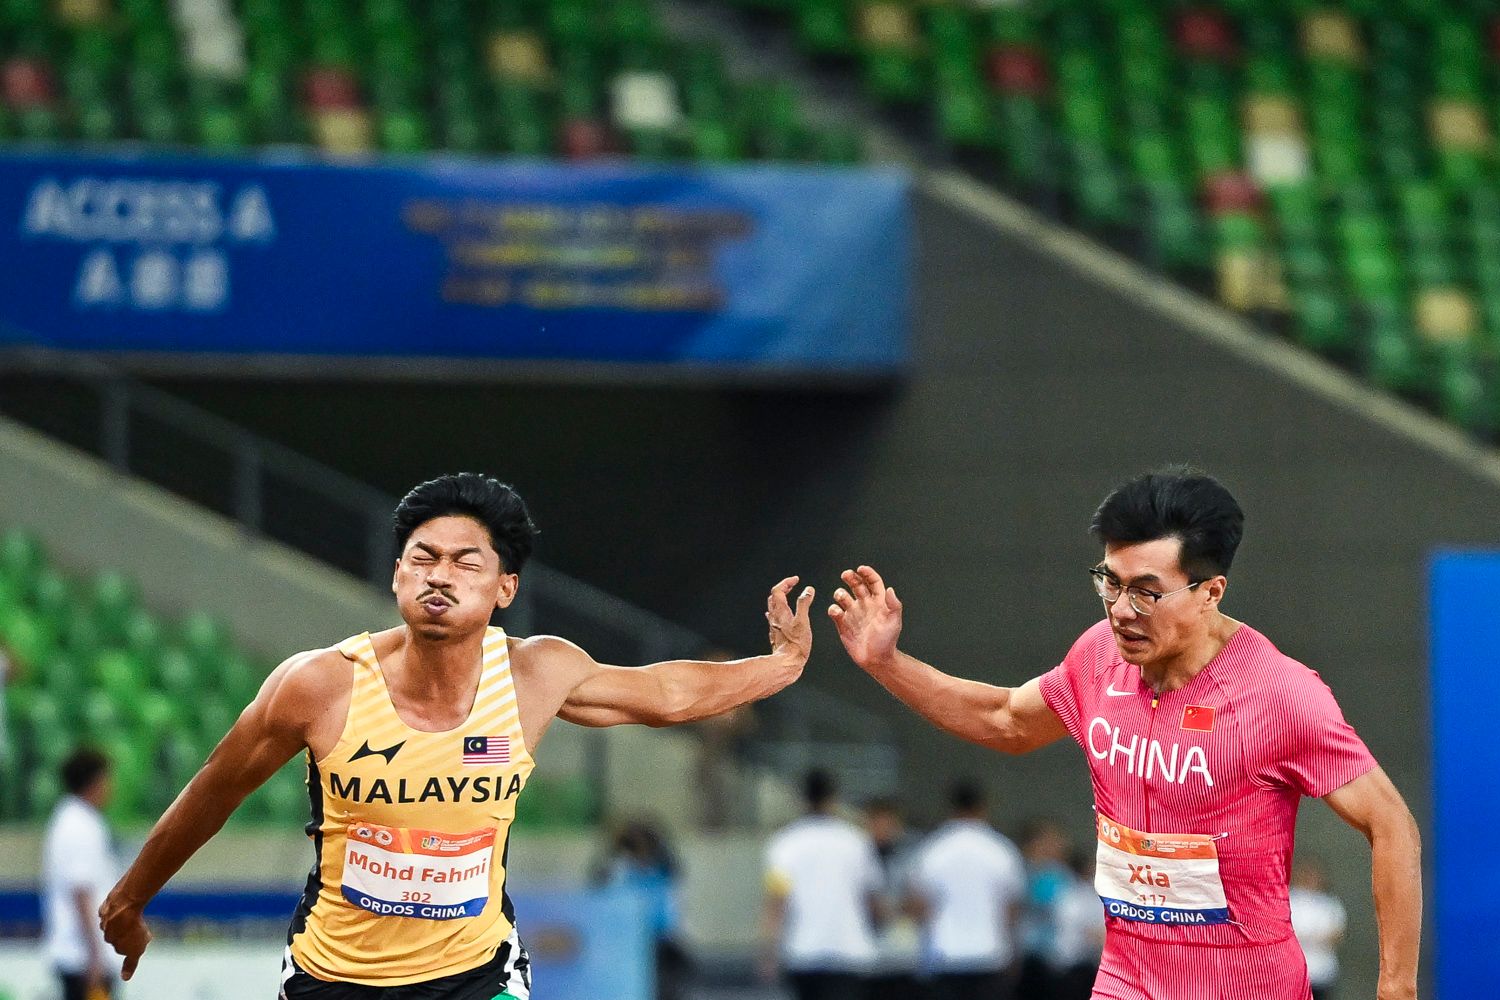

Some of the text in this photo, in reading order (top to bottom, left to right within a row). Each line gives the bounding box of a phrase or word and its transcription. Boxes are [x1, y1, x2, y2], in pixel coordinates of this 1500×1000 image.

[1088, 716, 1214, 787] CHINA
[329, 772, 521, 804] MALAYSIA
[348, 850, 487, 883] Mohd Fahmi
[1128, 863, 1171, 888] Xia
[360, 897, 466, 918] ORDOS CHINA
[401, 891, 432, 903] 302
[1109, 902, 1206, 923] ORDOS CHINA
